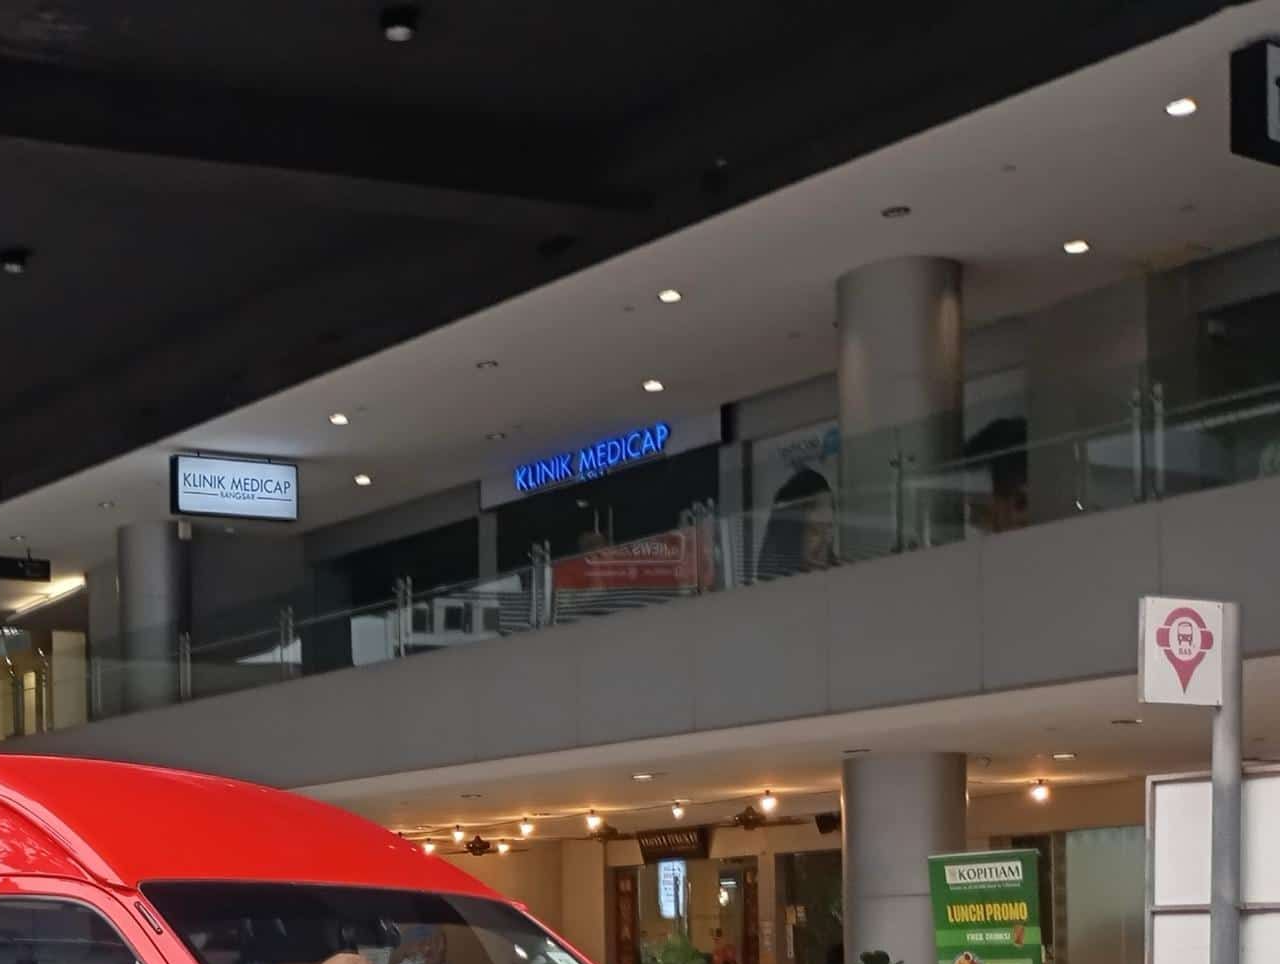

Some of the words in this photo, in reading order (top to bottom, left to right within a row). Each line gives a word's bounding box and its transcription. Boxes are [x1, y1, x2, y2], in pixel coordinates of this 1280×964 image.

[515, 454, 573, 492] KLINIK
[578, 421, 671, 473] MEDICAP
[183, 472, 226, 490] KLINIK
[230, 477, 291, 495] MEDICAP
[957, 864, 1021, 881] KOPITIAM
[946, 903, 985, 923] LUNCH
[985, 900, 1029, 921] PROMO
